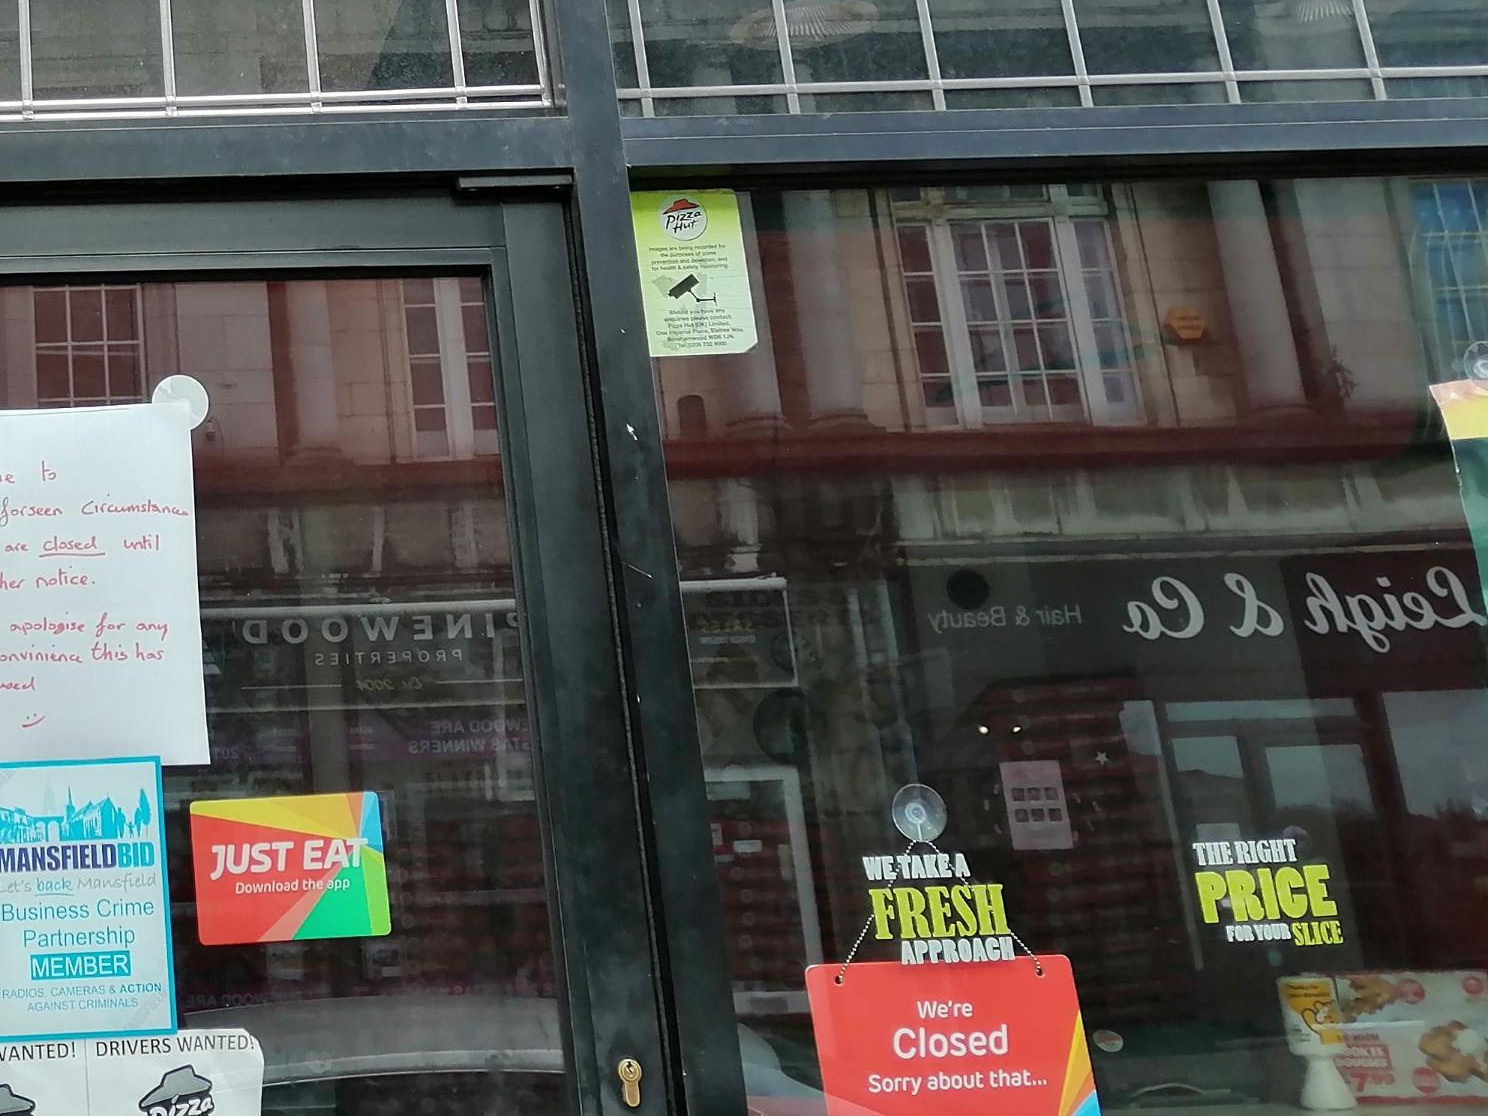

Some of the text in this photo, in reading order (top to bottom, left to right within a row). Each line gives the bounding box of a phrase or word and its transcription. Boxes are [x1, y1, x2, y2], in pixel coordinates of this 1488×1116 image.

[666, 211, 702, 230] Pizza
[673, 220, 697, 233] Hut
[42, 461, 56, 481] to
[5, 543, 29, 552] are
[42, 536, 98, 552] closed
[124, 535, 160, 551] until
[96, 612, 126, 636] for
[136, 622, 168, 641] any
[91, 642, 128, 661] this
[136, 643, 164, 661] has
[210, 837, 368, 881] JUST EAT
[1193, 839, 1298, 866] THE RIGHT
[862, 853, 971, 880] WE TAKE A
[37, 878, 73, 892] back
[77, 873, 157, 892] Mansfield
[235, 878, 351, 894] Download the app
[1195, 865, 1338, 923] PRICE
[2, 899, 154, 921] Business Crime
[868, 883, 1012, 940] FRESH
[23, 926, 135, 949] Partnership
[1226, 921, 1344, 946] FOR YOUR SLICE
[901, 937, 1015, 964] APPROACH
[31, 954, 129, 977] MEMBER
[51, 985, 105, 997] CAMERAS
[120, 983, 161, 993] ACTION
[27, 998, 138, 1012] AGAINST CRIMINALS
[917, 1000, 973, 1019] We're
[96, 1034, 255, 1057] DRIVERS WANTED!
[892, 1024, 1009, 1059] Closed
[868, 1069, 1048, 1096] Sorry about that...
